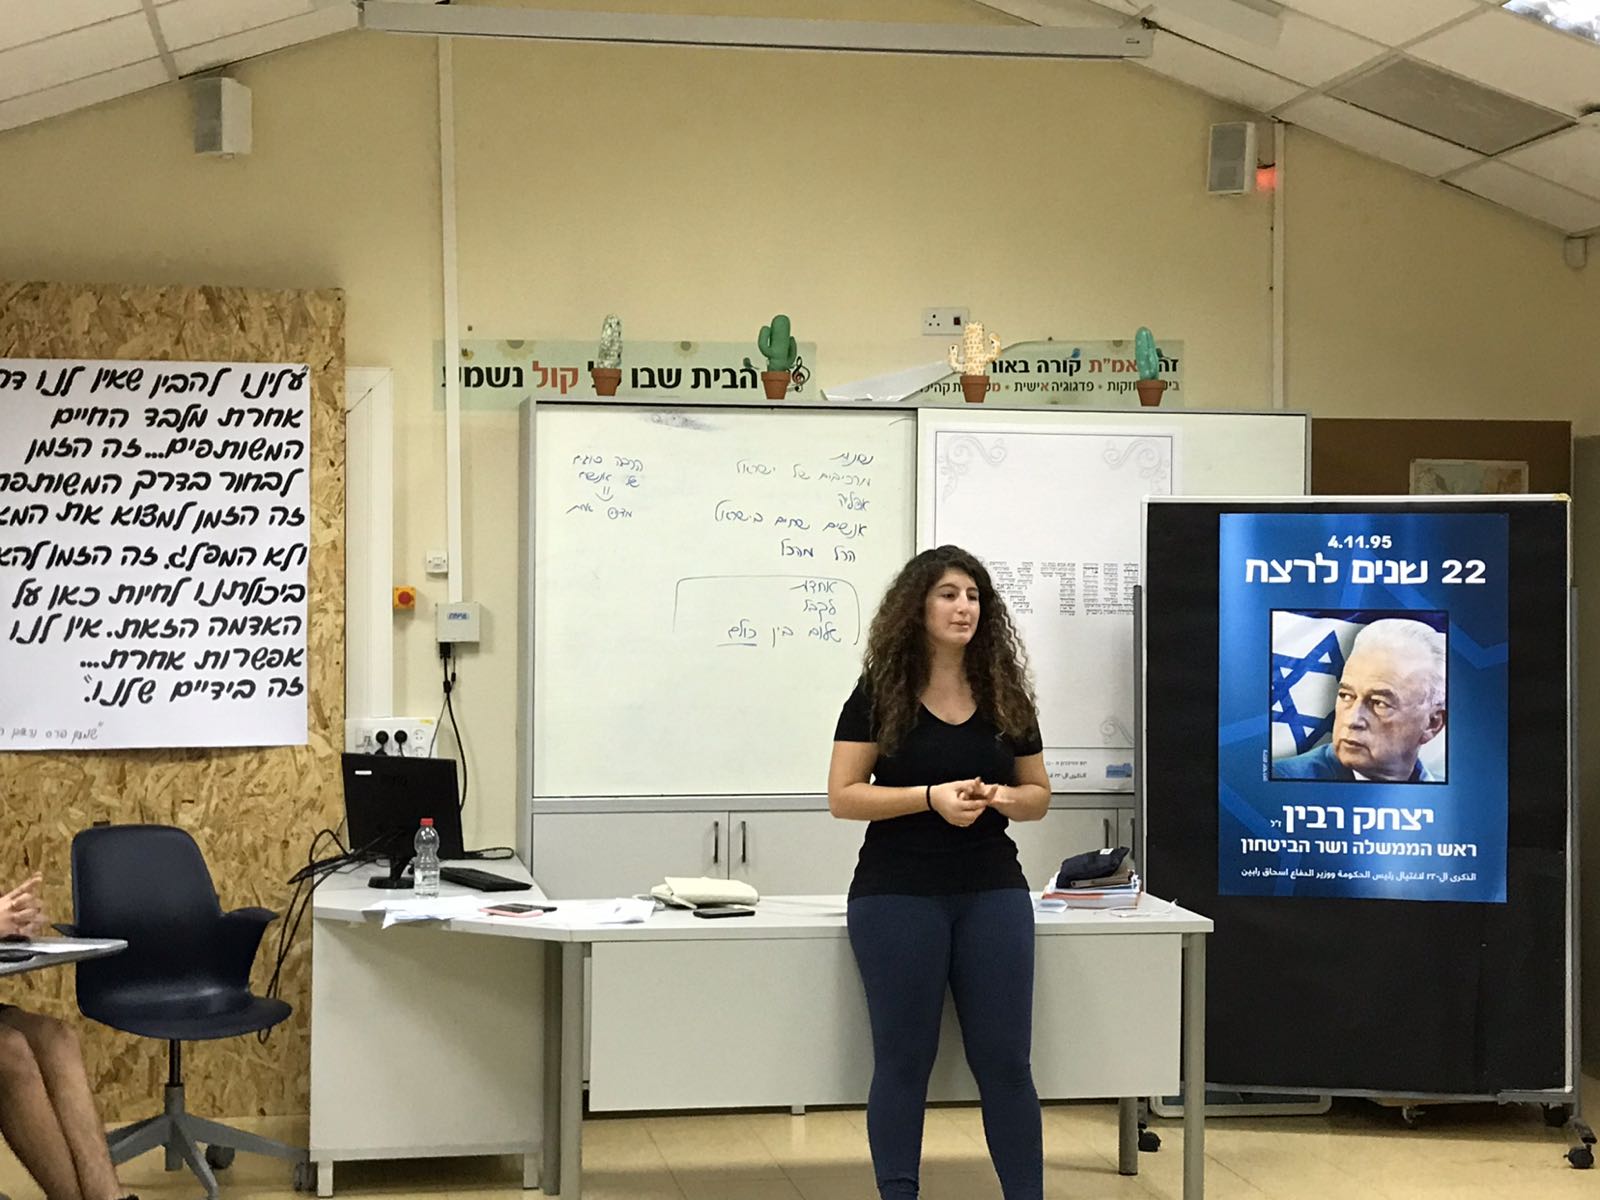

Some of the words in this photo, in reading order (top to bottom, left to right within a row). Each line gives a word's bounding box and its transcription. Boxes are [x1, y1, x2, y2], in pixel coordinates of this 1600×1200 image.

[441, 364, 525, 389] נשמ
[532, 358, 580, 396] קול
[690, 360, 760, 390] הבית
[1036, 358, 1082, 377] קורה
[1088, 357, 1139, 374] אמ"ת
[1158, 358, 1179, 373] זה
[35, 365, 87, 398] לנו
[89, 367, 144, 394] שאין
[148, 367, 233, 400] להבין
[631, 367, 682, 389] שבו
[919, 381, 951, 396] קהיל
[1014, 381, 1049, 393] אישית
[1051, 379, 1095, 393] פדגוגיה
[50, 406, 130, 430] החיים
[144, 403, 209, 434] מלבד
[217, 407, 304, 429] אחרת
[23, 436, 93, 465] הזמן
[219, 467, 305, 498] לבחור
[792, 462, 811, 482] של
[129, 469, 212, 501] בדרך
[55, 501, 104, 526] את
[110, 501, 200, 534] למצוא
[191, 505, 260, 535] הזמן
[268, 506, 306, 527] זה
[714, 499, 764, 523] בישראל
[821, 519, 869, 540] אנשים
[1327, 535, 1392, 549] 4.11.95
[45, 543, 113, 570] הזמן
[120, 545, 159, 567] זה
[163, 542, 257, 571] המפלג.
[262, 542, 308, 572] ולא
[1245, 552, 1339, 584] לרצח
[1351, 559, 1428, 585] שנים
[1441, 559, 1486, 584] 22
[11, 578, 43, 609] על
[47, 584, 101, 611] כאן
[108, 576, 192, 607] לחיות
[193, 576, 306, 607] ביכולתנו
[9, 613, 63, 645] לנו
[63, 616, 103, 642] אין
[106, 618, 199, 640] הזאת.
[208, 615, 302, 637] האדמה
[771, 625, 795, 649] בין
[808, 620, 843, 644] שלום
[80, 649, 186, 671] אחרת...
[194, 647, 305, 671] אפשרות
[169, 679, 256, 702] בידיים
[268, 676, 304, 698] זה
[44, 728, 69, 740] פרס
[1282, 805, 1345, 833] רבין
[1352, 806, 1434, 835] יצחק
[1240, 838, 1310, 854] הביטחון
[1314, 840, 1348, 854] ושר
[1352, 839, 1433, 857] הממשלה
[1436, 843, 1477, 857] ראש
[1240, 865, 1262, 878] رابين
[1262, 866, 1289, 878] اسحاق
[1290, 867, 1315, 880] الدفاع
[1316, 868, 1336, 880] ووزير
[1337, 868, 1371, 880] الحكومة
[1372, 870, 1395, 882] رئيس
[1396, 870, 1425, 883] لاغتيال
[1449, 871, 1478, 883] الذكرى
